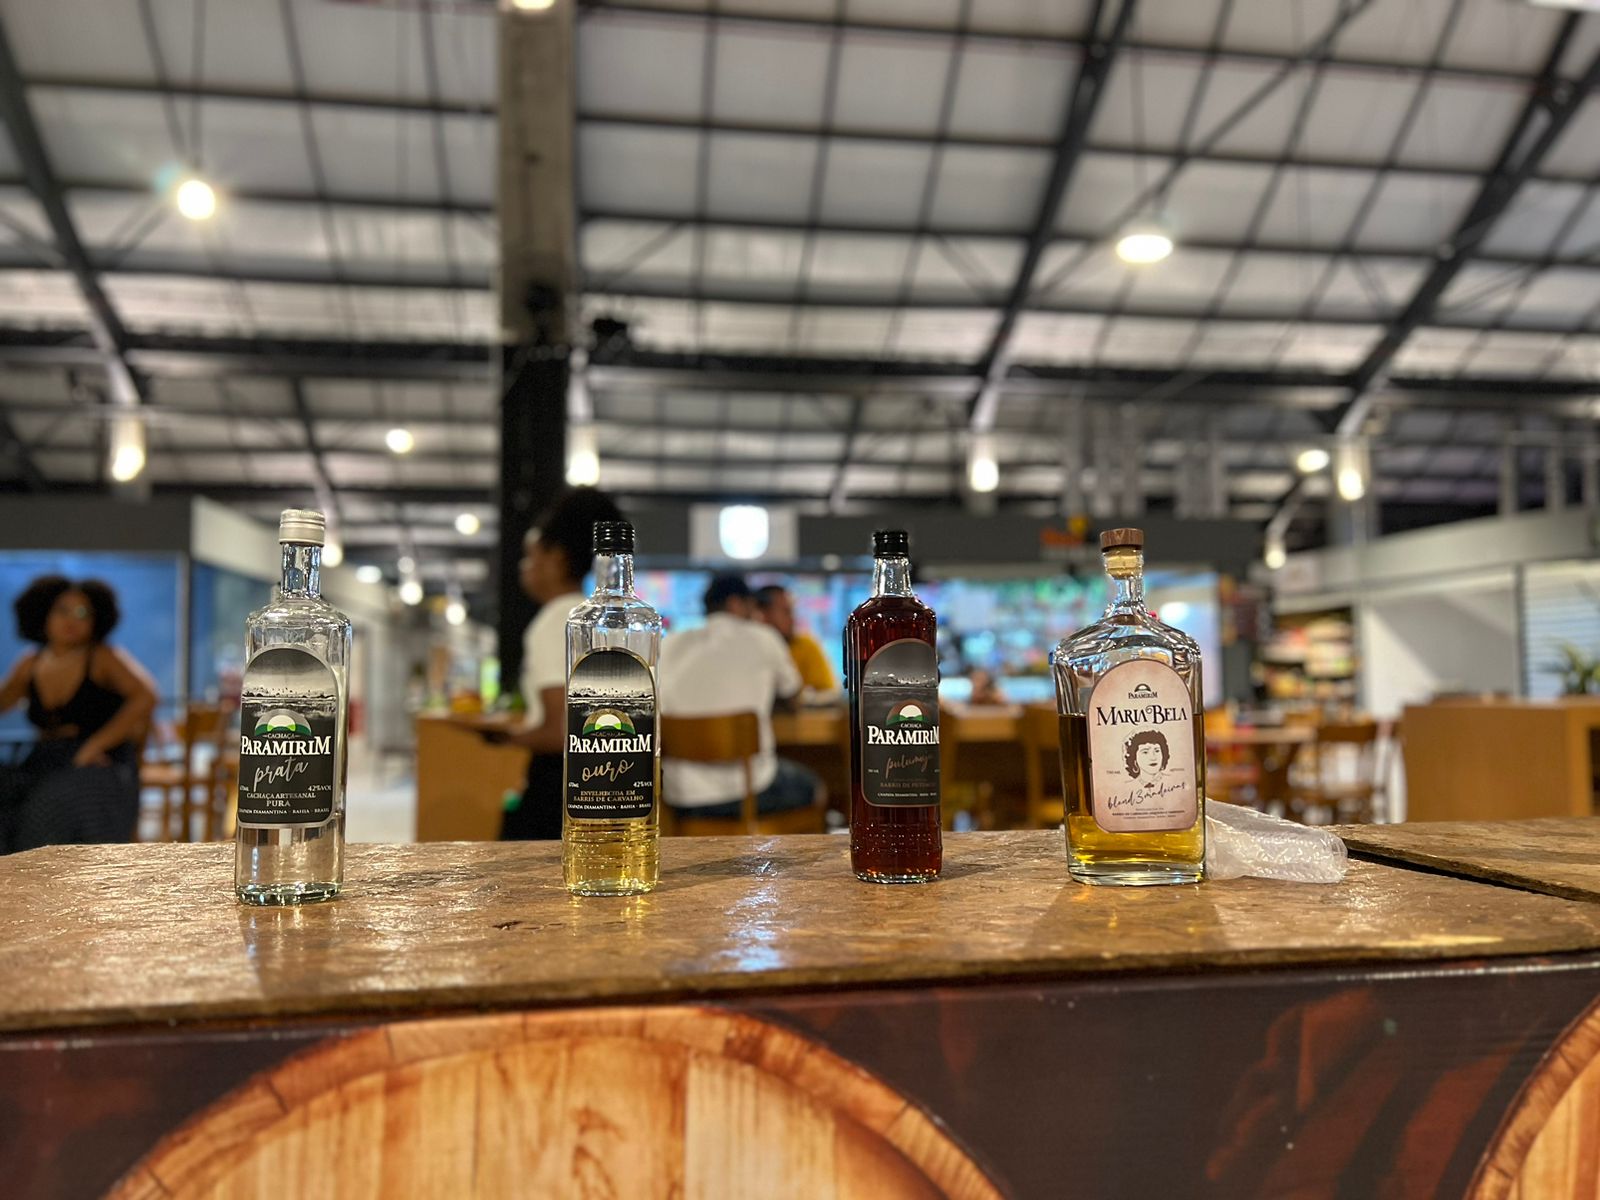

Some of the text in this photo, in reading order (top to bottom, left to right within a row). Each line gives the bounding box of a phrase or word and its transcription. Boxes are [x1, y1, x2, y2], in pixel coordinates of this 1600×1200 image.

[1128, 691, 1158, 699] PARAMIRIM
[1096, 705, 1187, 726] MARIA BELA
[241, 735, 331, 756] PARAMIRIM
[569, 734, 652, 753] PARAMIRIM
[254, 756, 309, 792] prata
[582, 759, 635, 782] ouro
